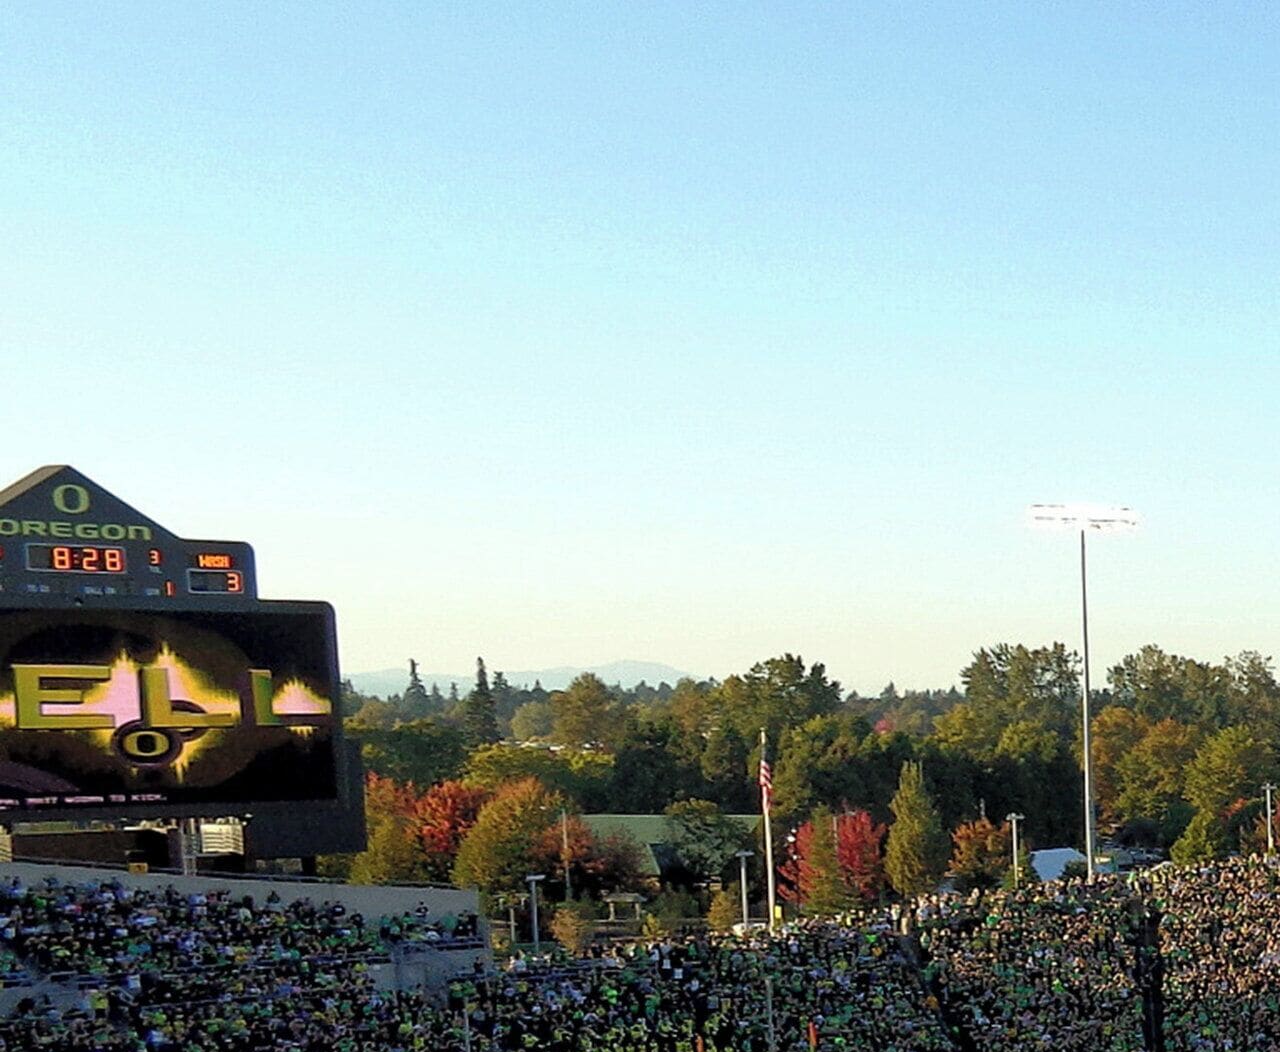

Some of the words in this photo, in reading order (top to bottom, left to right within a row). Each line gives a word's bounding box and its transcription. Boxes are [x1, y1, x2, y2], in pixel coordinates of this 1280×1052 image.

[53, 485, 90, 514] O
[0, 519, 151, 540] OREGON
[53, 547, 122, 572] 8:28
[150, 551, 159, 565] 3
[227, 573, 240, 591] 3
